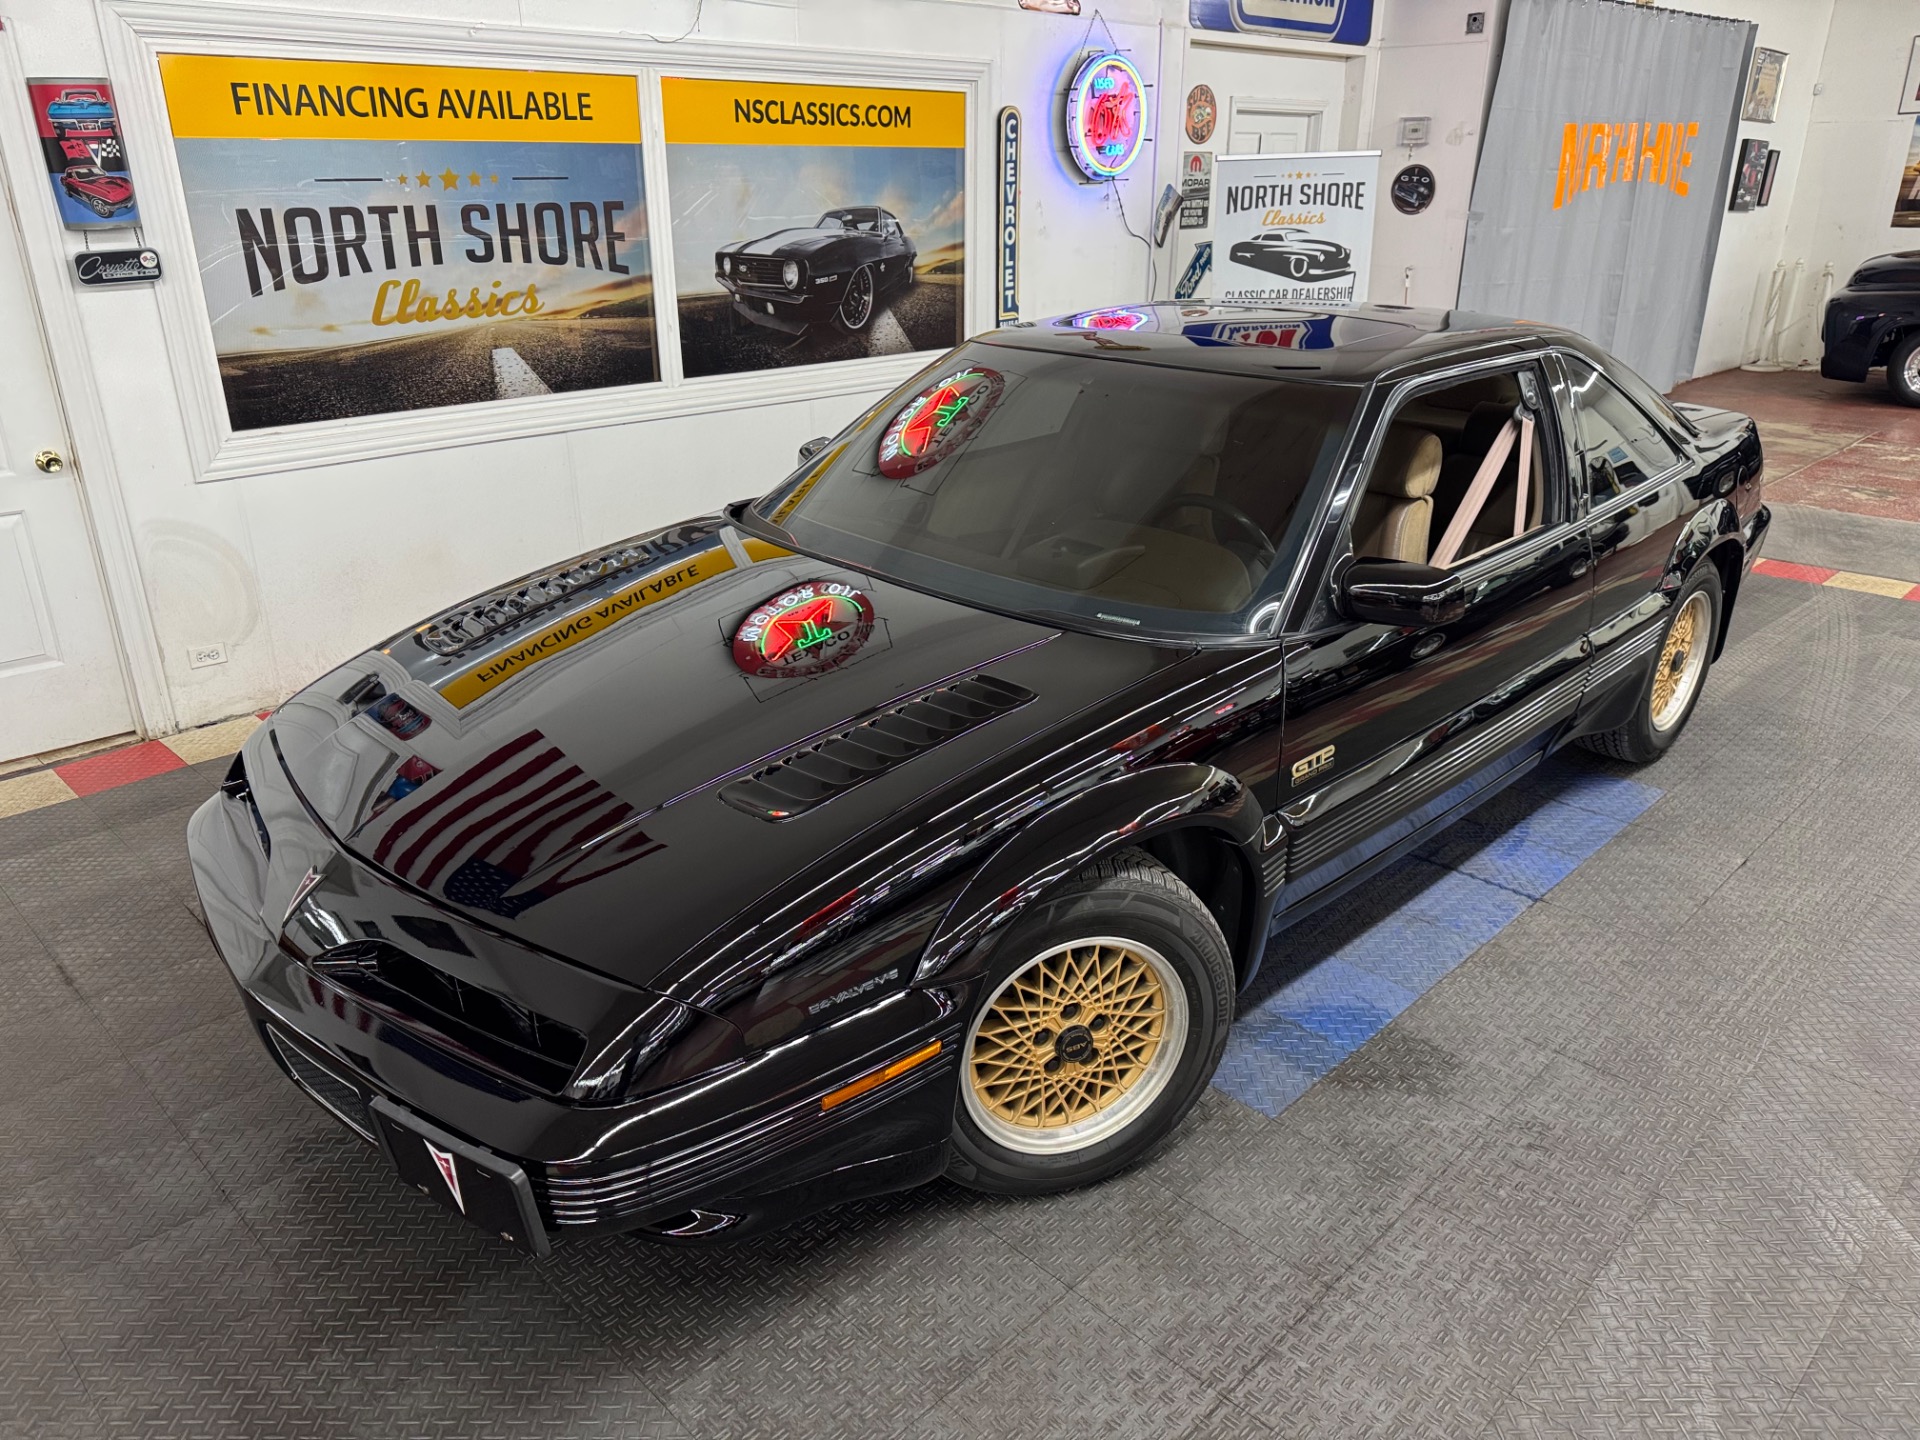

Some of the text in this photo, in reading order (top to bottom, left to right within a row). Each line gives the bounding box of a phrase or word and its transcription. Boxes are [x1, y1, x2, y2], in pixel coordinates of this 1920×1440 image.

[230, 82, 593, 121] FINANCING AVAILABLE
[734, 98, 911, 128] NSCLASSICS.COM
[1092, 82, 1133, 146] OK
[1191, 119, 1212, 141] BEE
[1182, 178, 1210, 187] MOPAR
[1400, 175, 1430, 184] GTO
[1004, 117, 1018, 309] CHEVROLET
[1226, 181, 1366, 215] NORTH SHORE
[1262, 209, 1326, 226] Classics
[235, 200, 630, 298] NORTH SHORE
[79, 256, 143, 279] Corvette
[1180, 262, 1202, 299] Ford
[371, 279, 545, 327] Classics
[1188, 928, 1231, 1028] BRIDGESTONE
